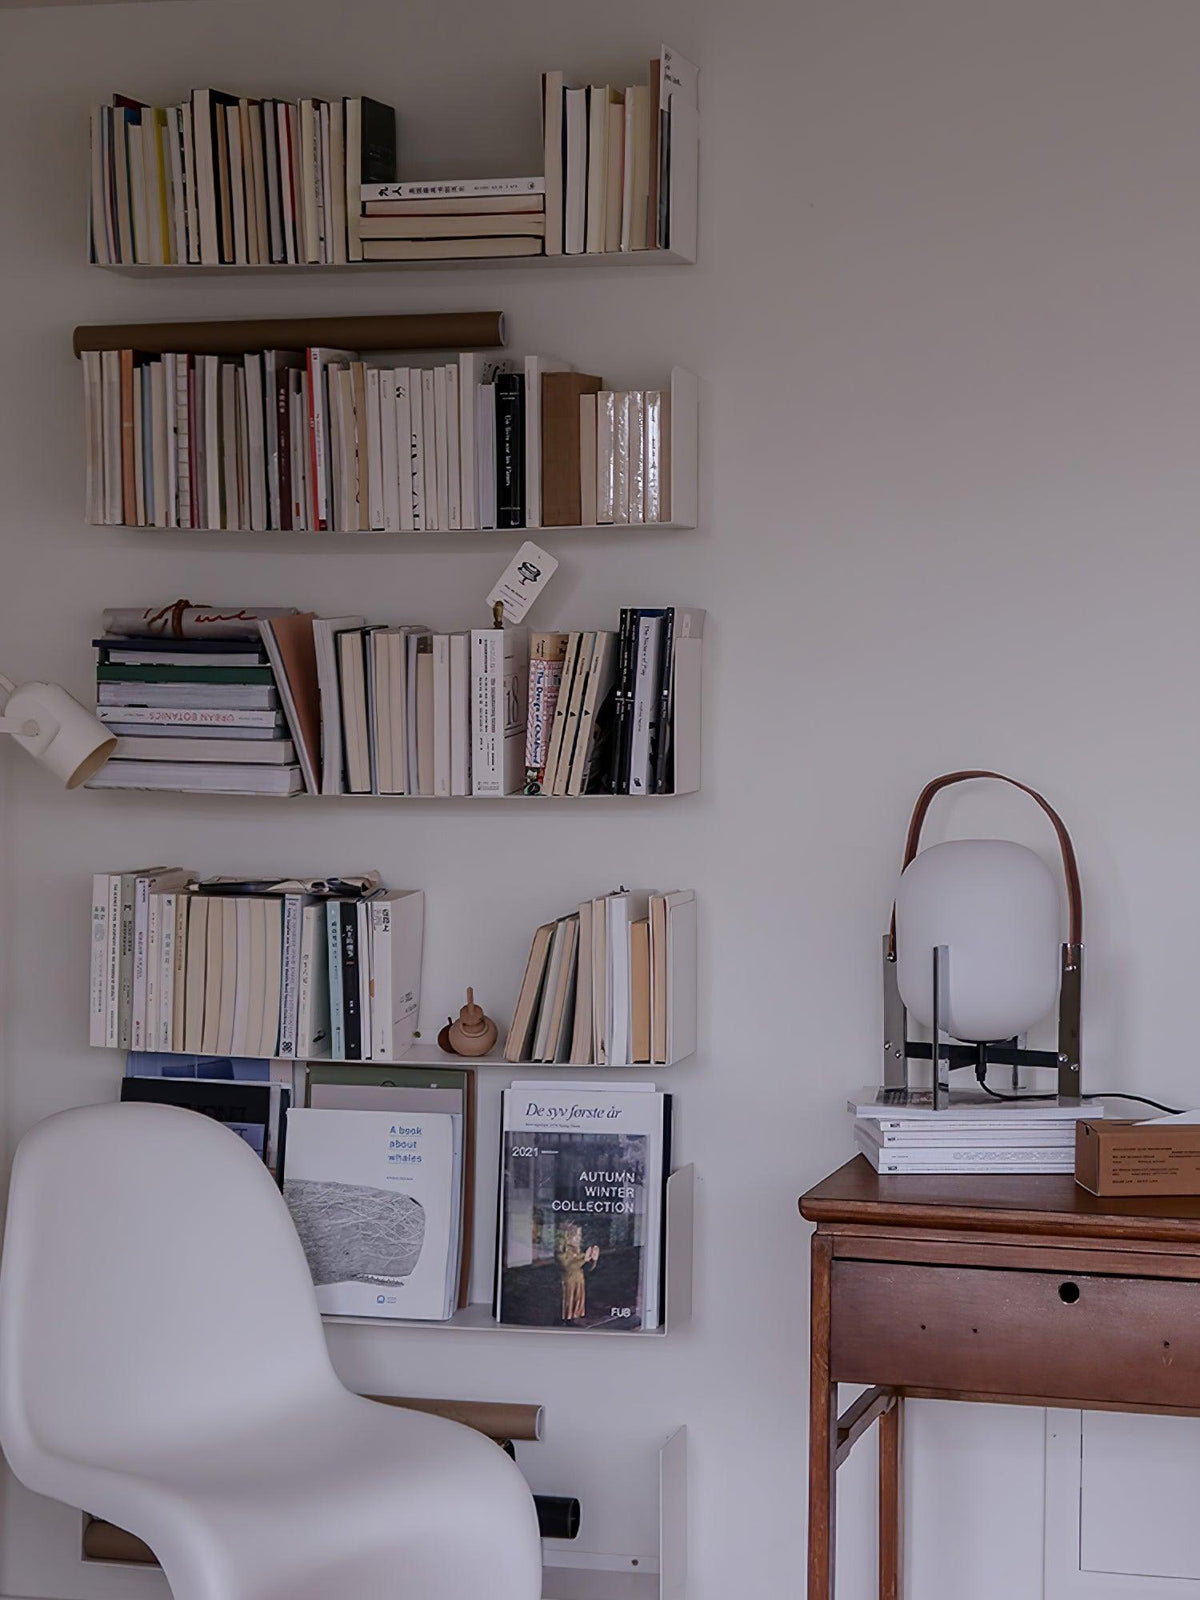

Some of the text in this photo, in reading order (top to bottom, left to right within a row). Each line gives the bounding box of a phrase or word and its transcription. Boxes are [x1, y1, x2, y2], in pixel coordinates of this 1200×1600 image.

[533, 686, 543, 712] Design
[149, 711, 197, 721] BOTANICS
[200, 712, 235, 722] URBAN
[526, 1102, 622, 1121] De syv første år
[389, 1125, 422, 1135] A book
[389, 1139, 417, 1149] about
[388, 1153, 422, 1163] whales
[579, 1171, 636, 1183] AUTUMN
[584, 1185, 635, 1198] WINTER
[551, 1199, 634, 1213] COLLECTION
